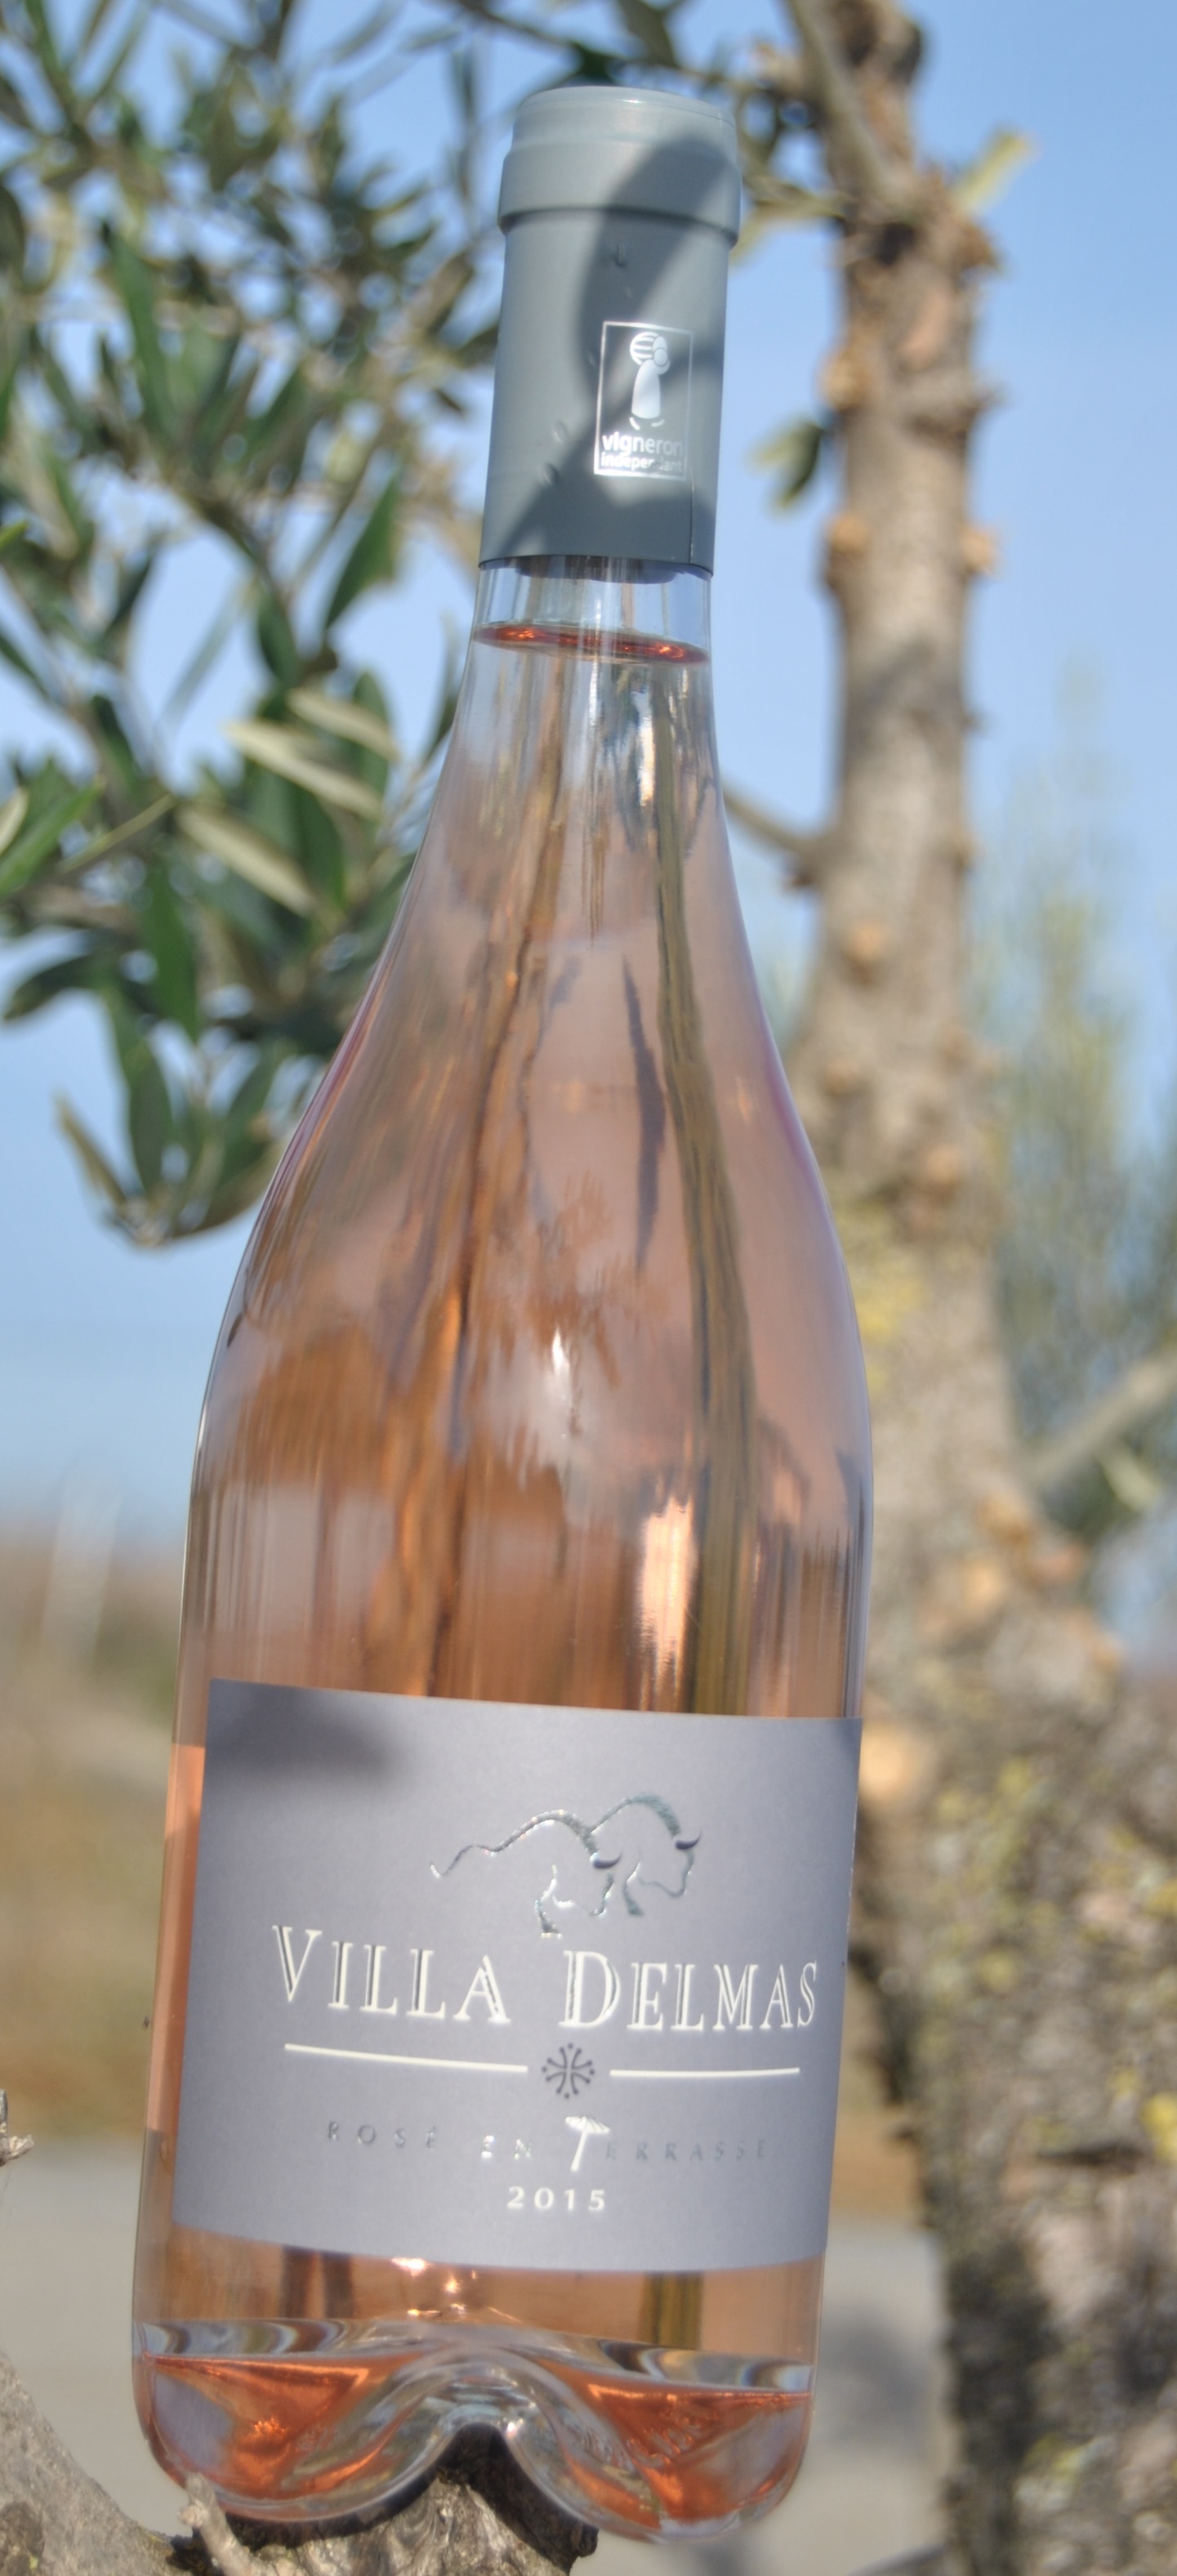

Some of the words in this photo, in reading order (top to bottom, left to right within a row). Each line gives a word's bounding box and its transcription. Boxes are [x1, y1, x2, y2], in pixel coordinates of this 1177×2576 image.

[602, 431, 683, 457] vigneron
[481, 2135, 532, 2159] EN
[506, 2186, 606, 2212] 2015
